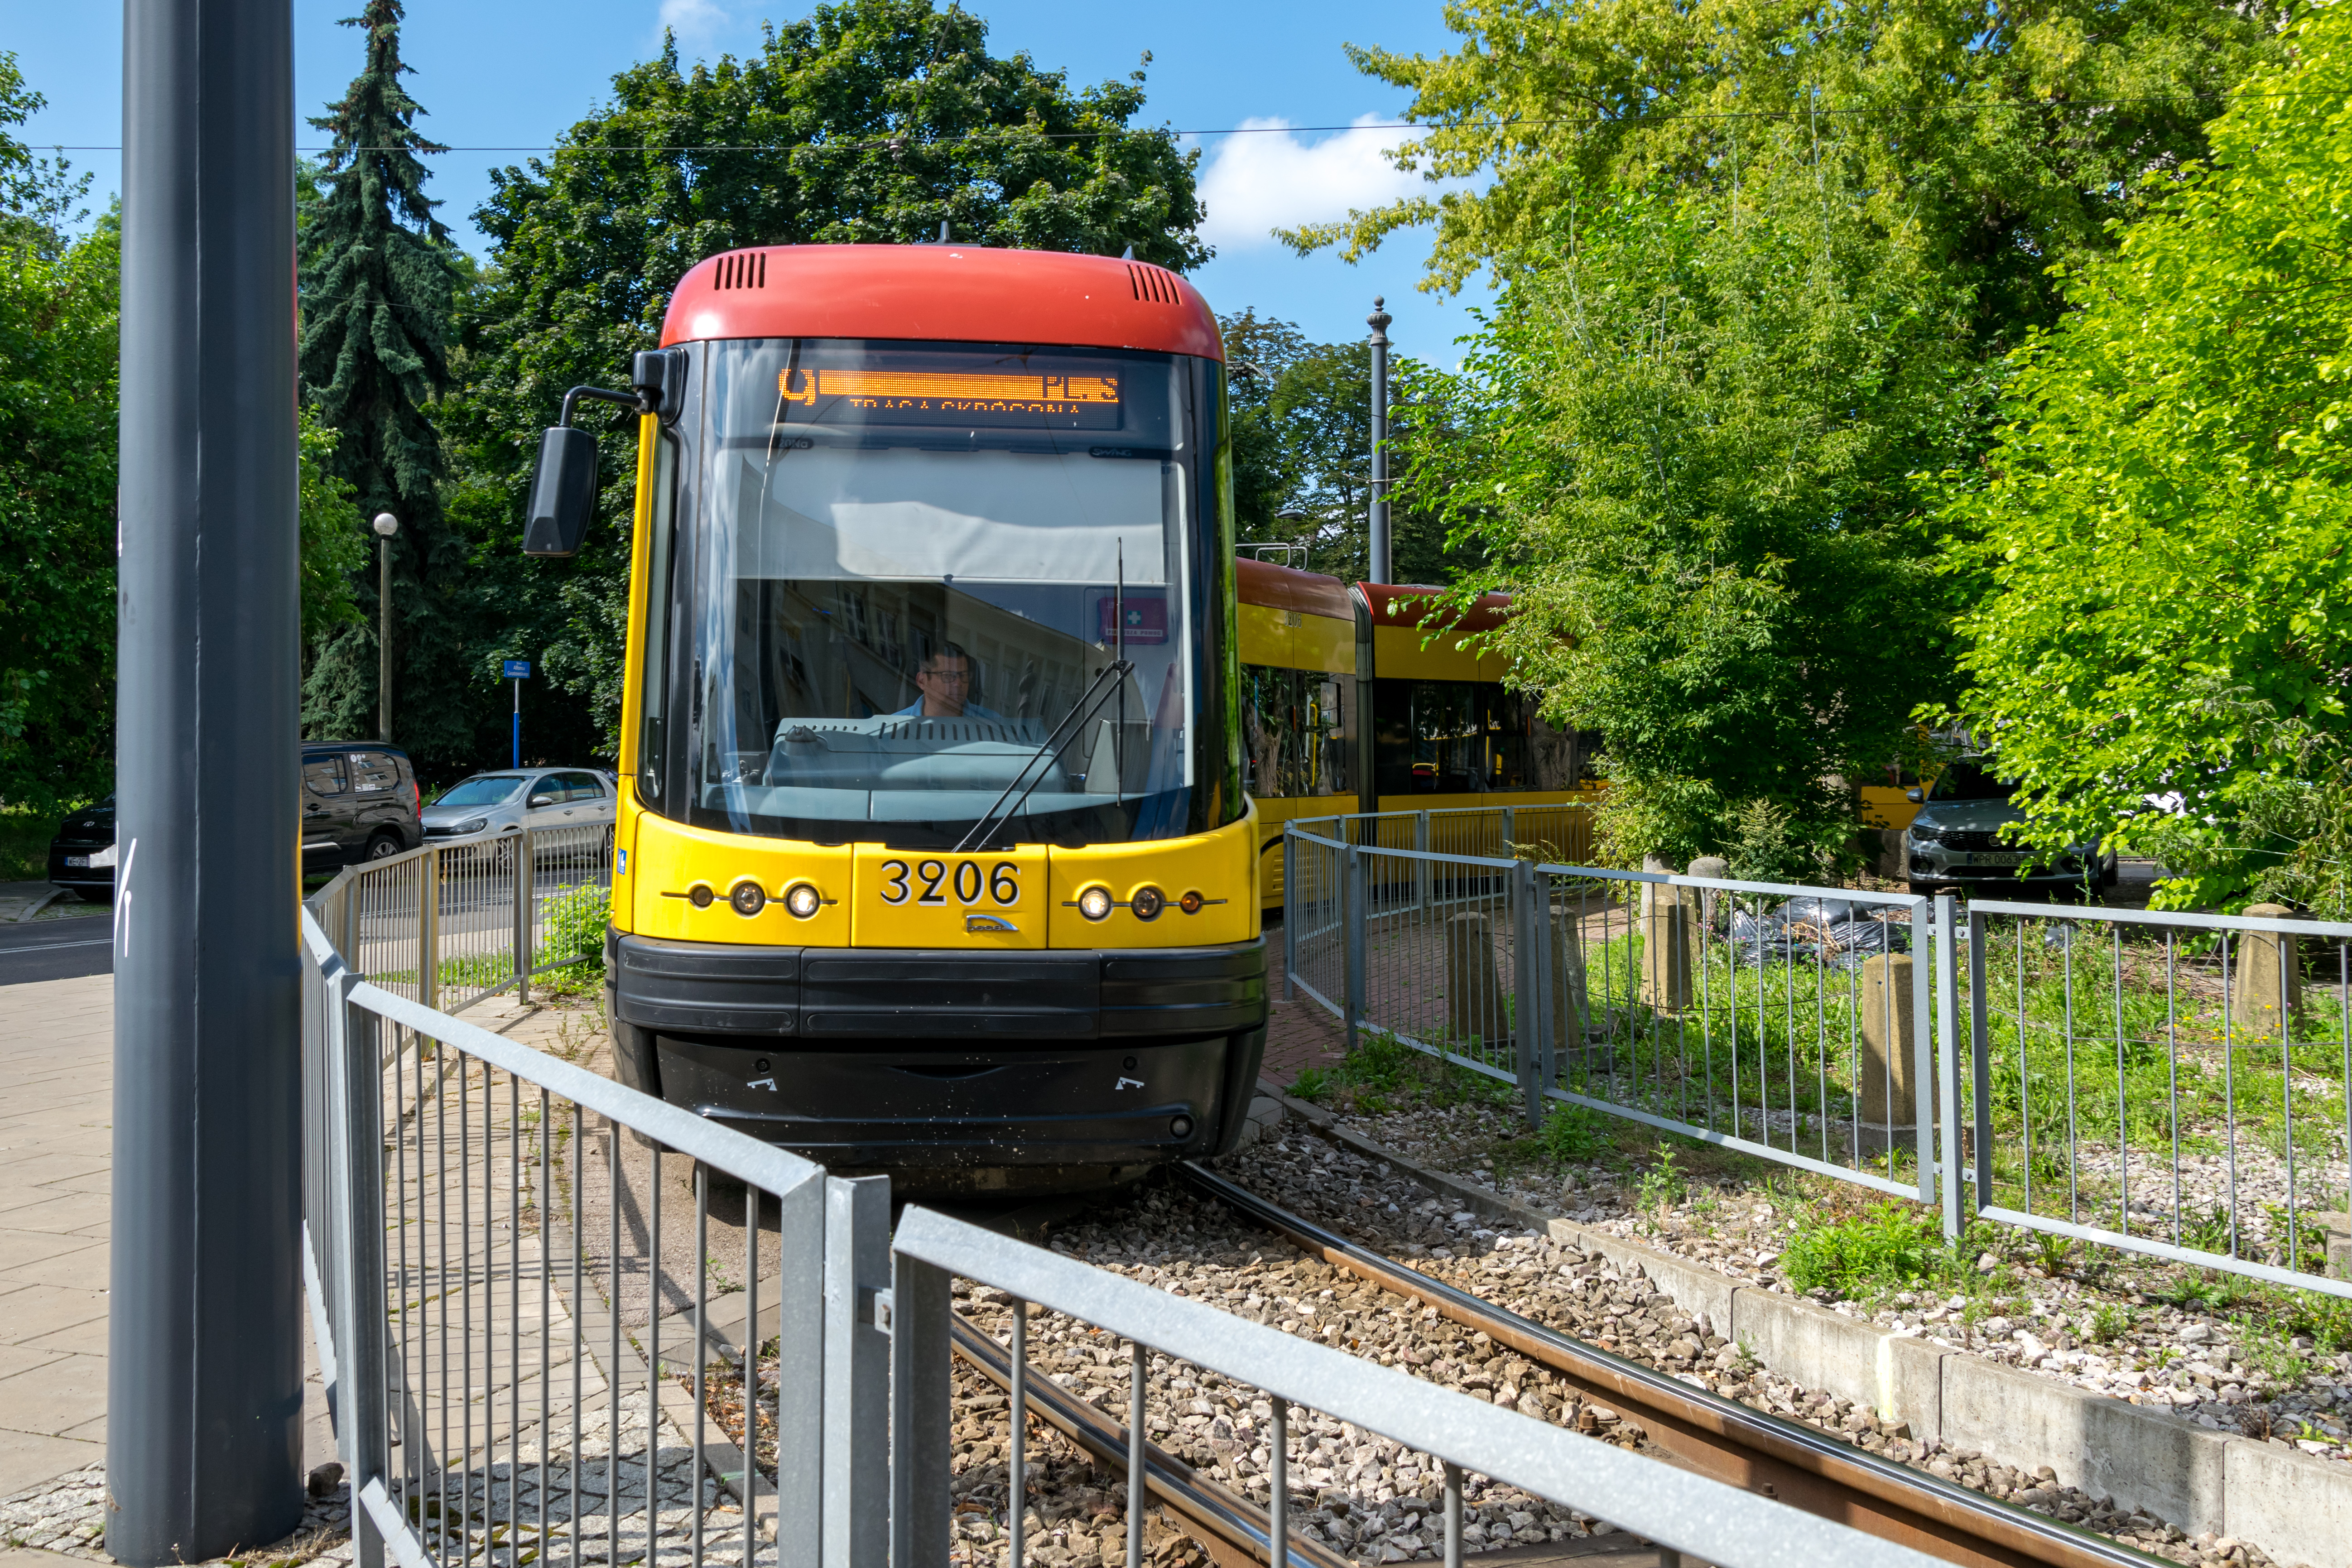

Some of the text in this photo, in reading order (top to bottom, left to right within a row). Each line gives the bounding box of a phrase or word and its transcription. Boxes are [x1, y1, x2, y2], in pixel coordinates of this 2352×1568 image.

[1284, 611, 1302, 629] 3206
[68, 857, 76, 866] WE
[1972, 855, 2025, 864] WPR 0063H
[880, 859, 1021, 907] 3206
